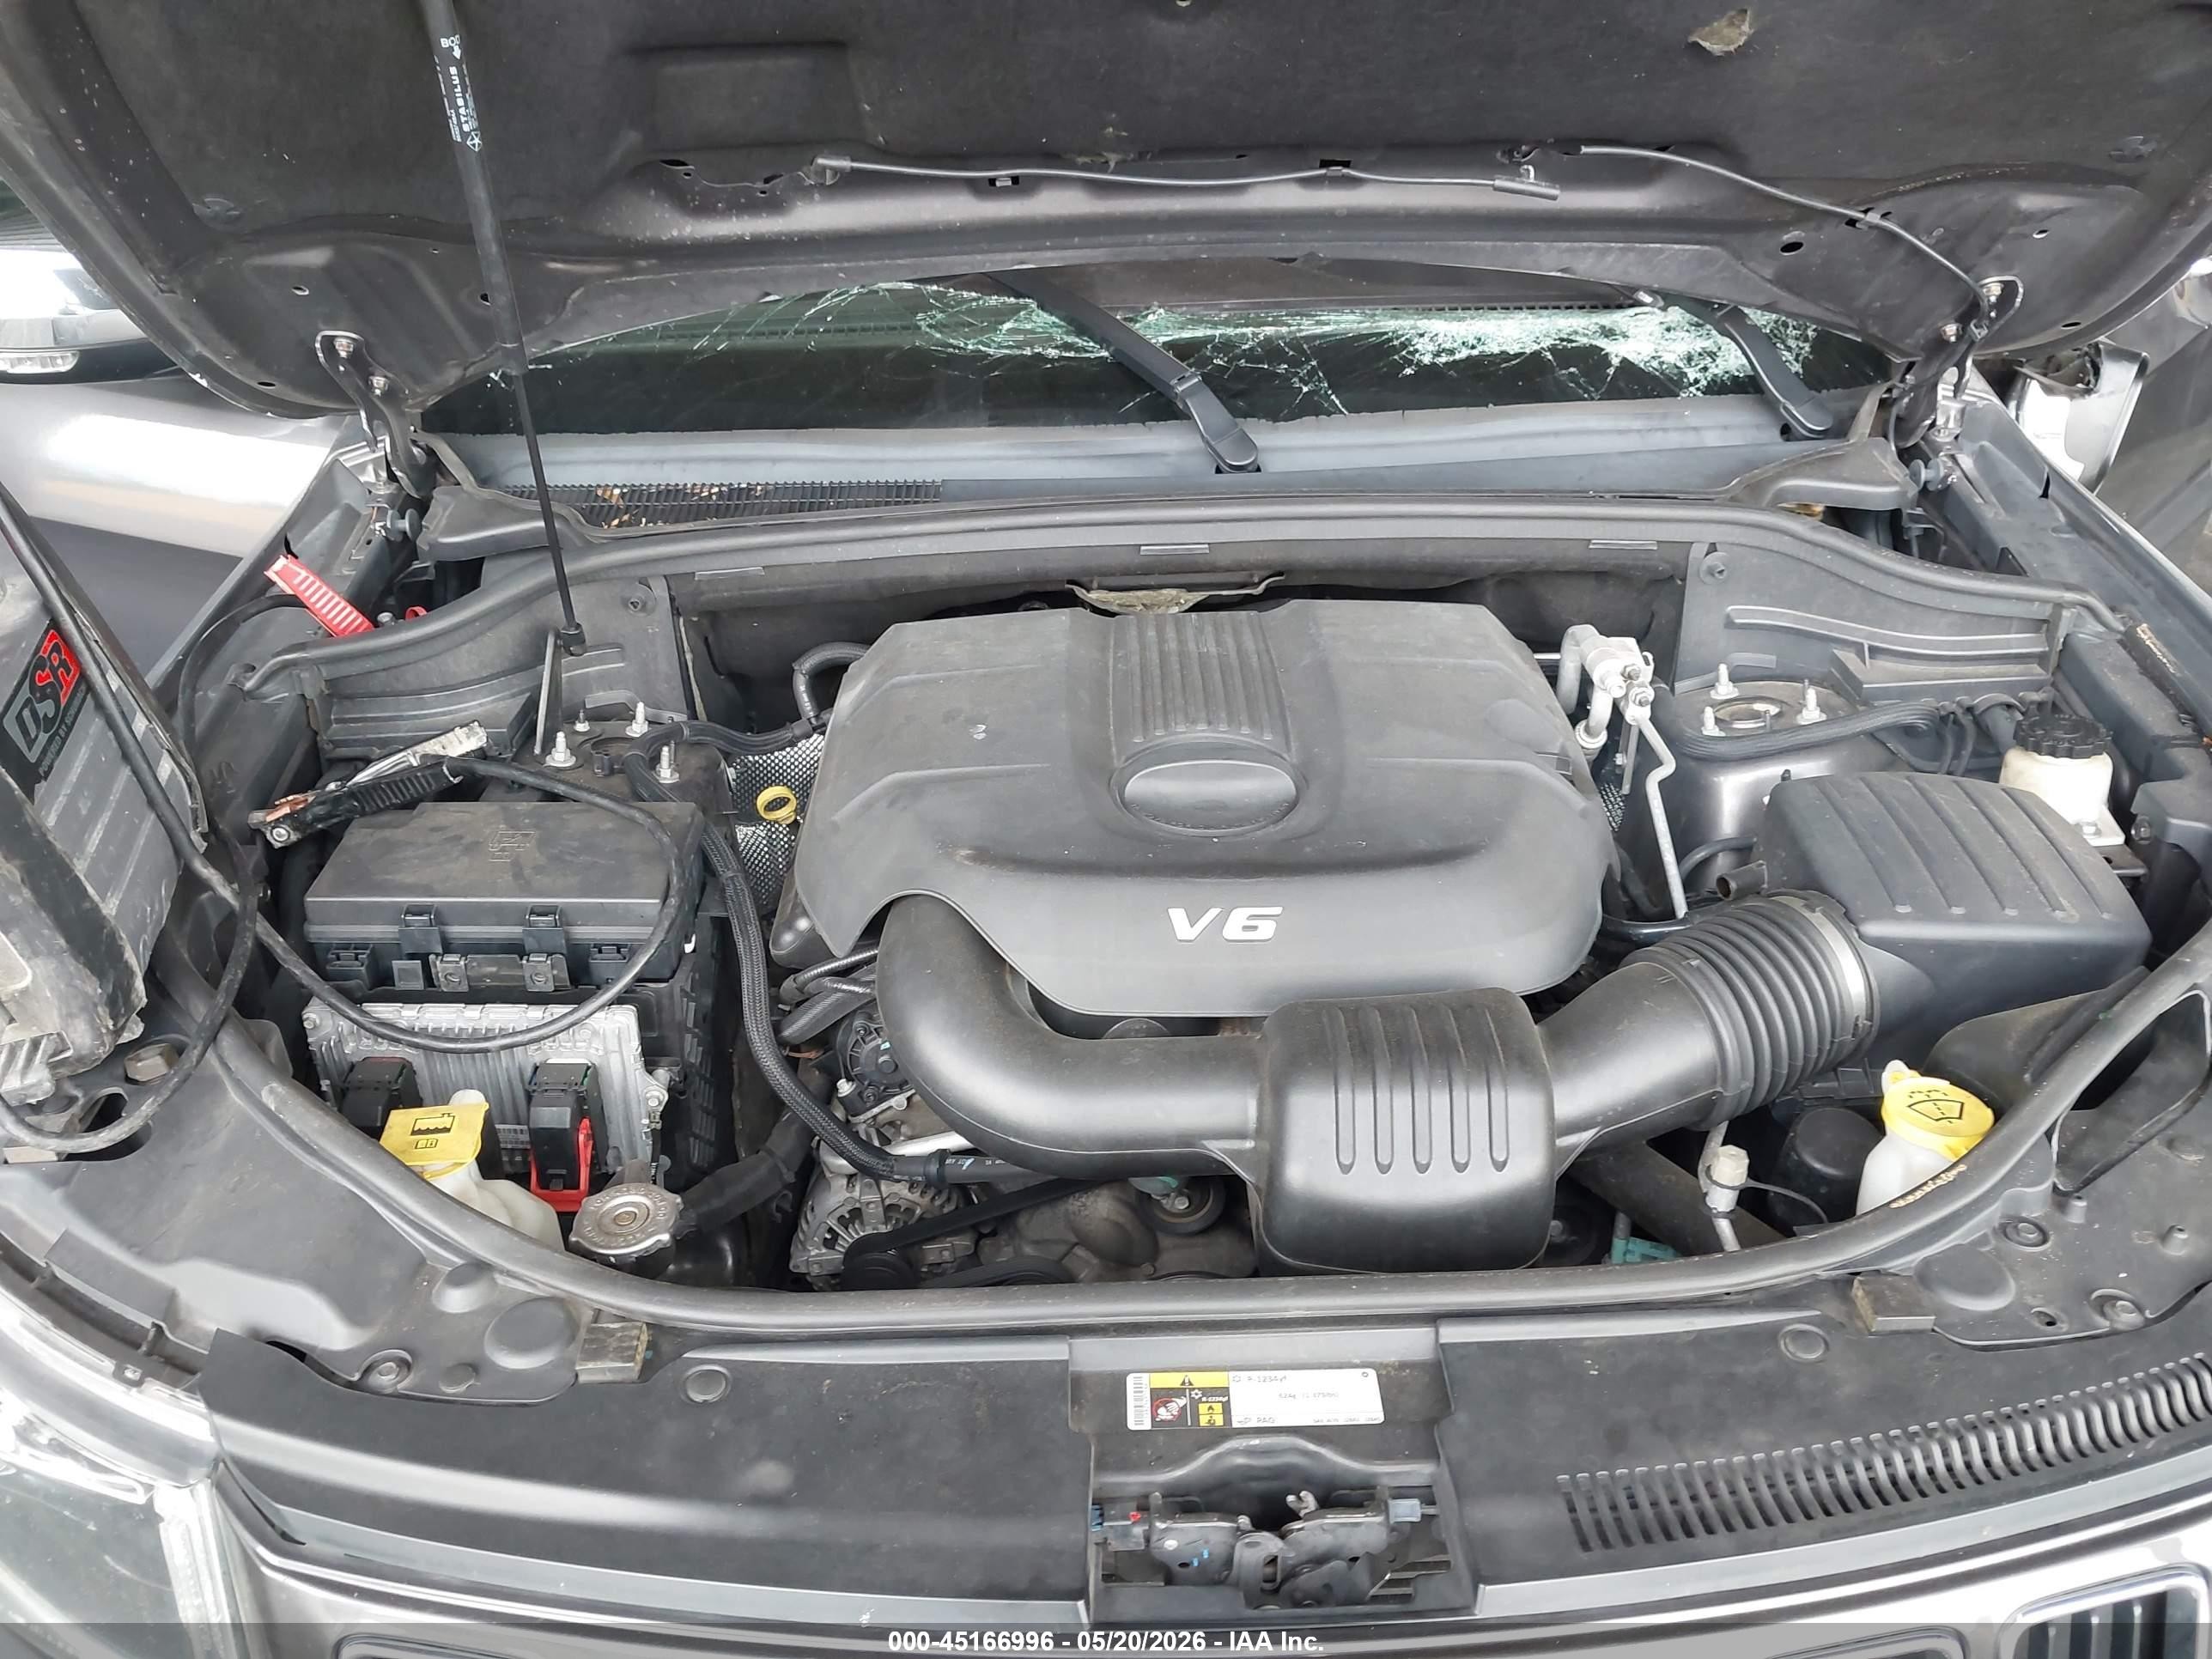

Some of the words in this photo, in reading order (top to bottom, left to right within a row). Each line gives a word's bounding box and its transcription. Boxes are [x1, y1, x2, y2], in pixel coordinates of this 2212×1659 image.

[449, 66, 471, 132] STABILUS
[10, 635, 77, 756] DSR
[38, 736, 62, 777] POWERED
[58, 724, 69, 738] BY
[1167, 906, 1283, 942] V6
